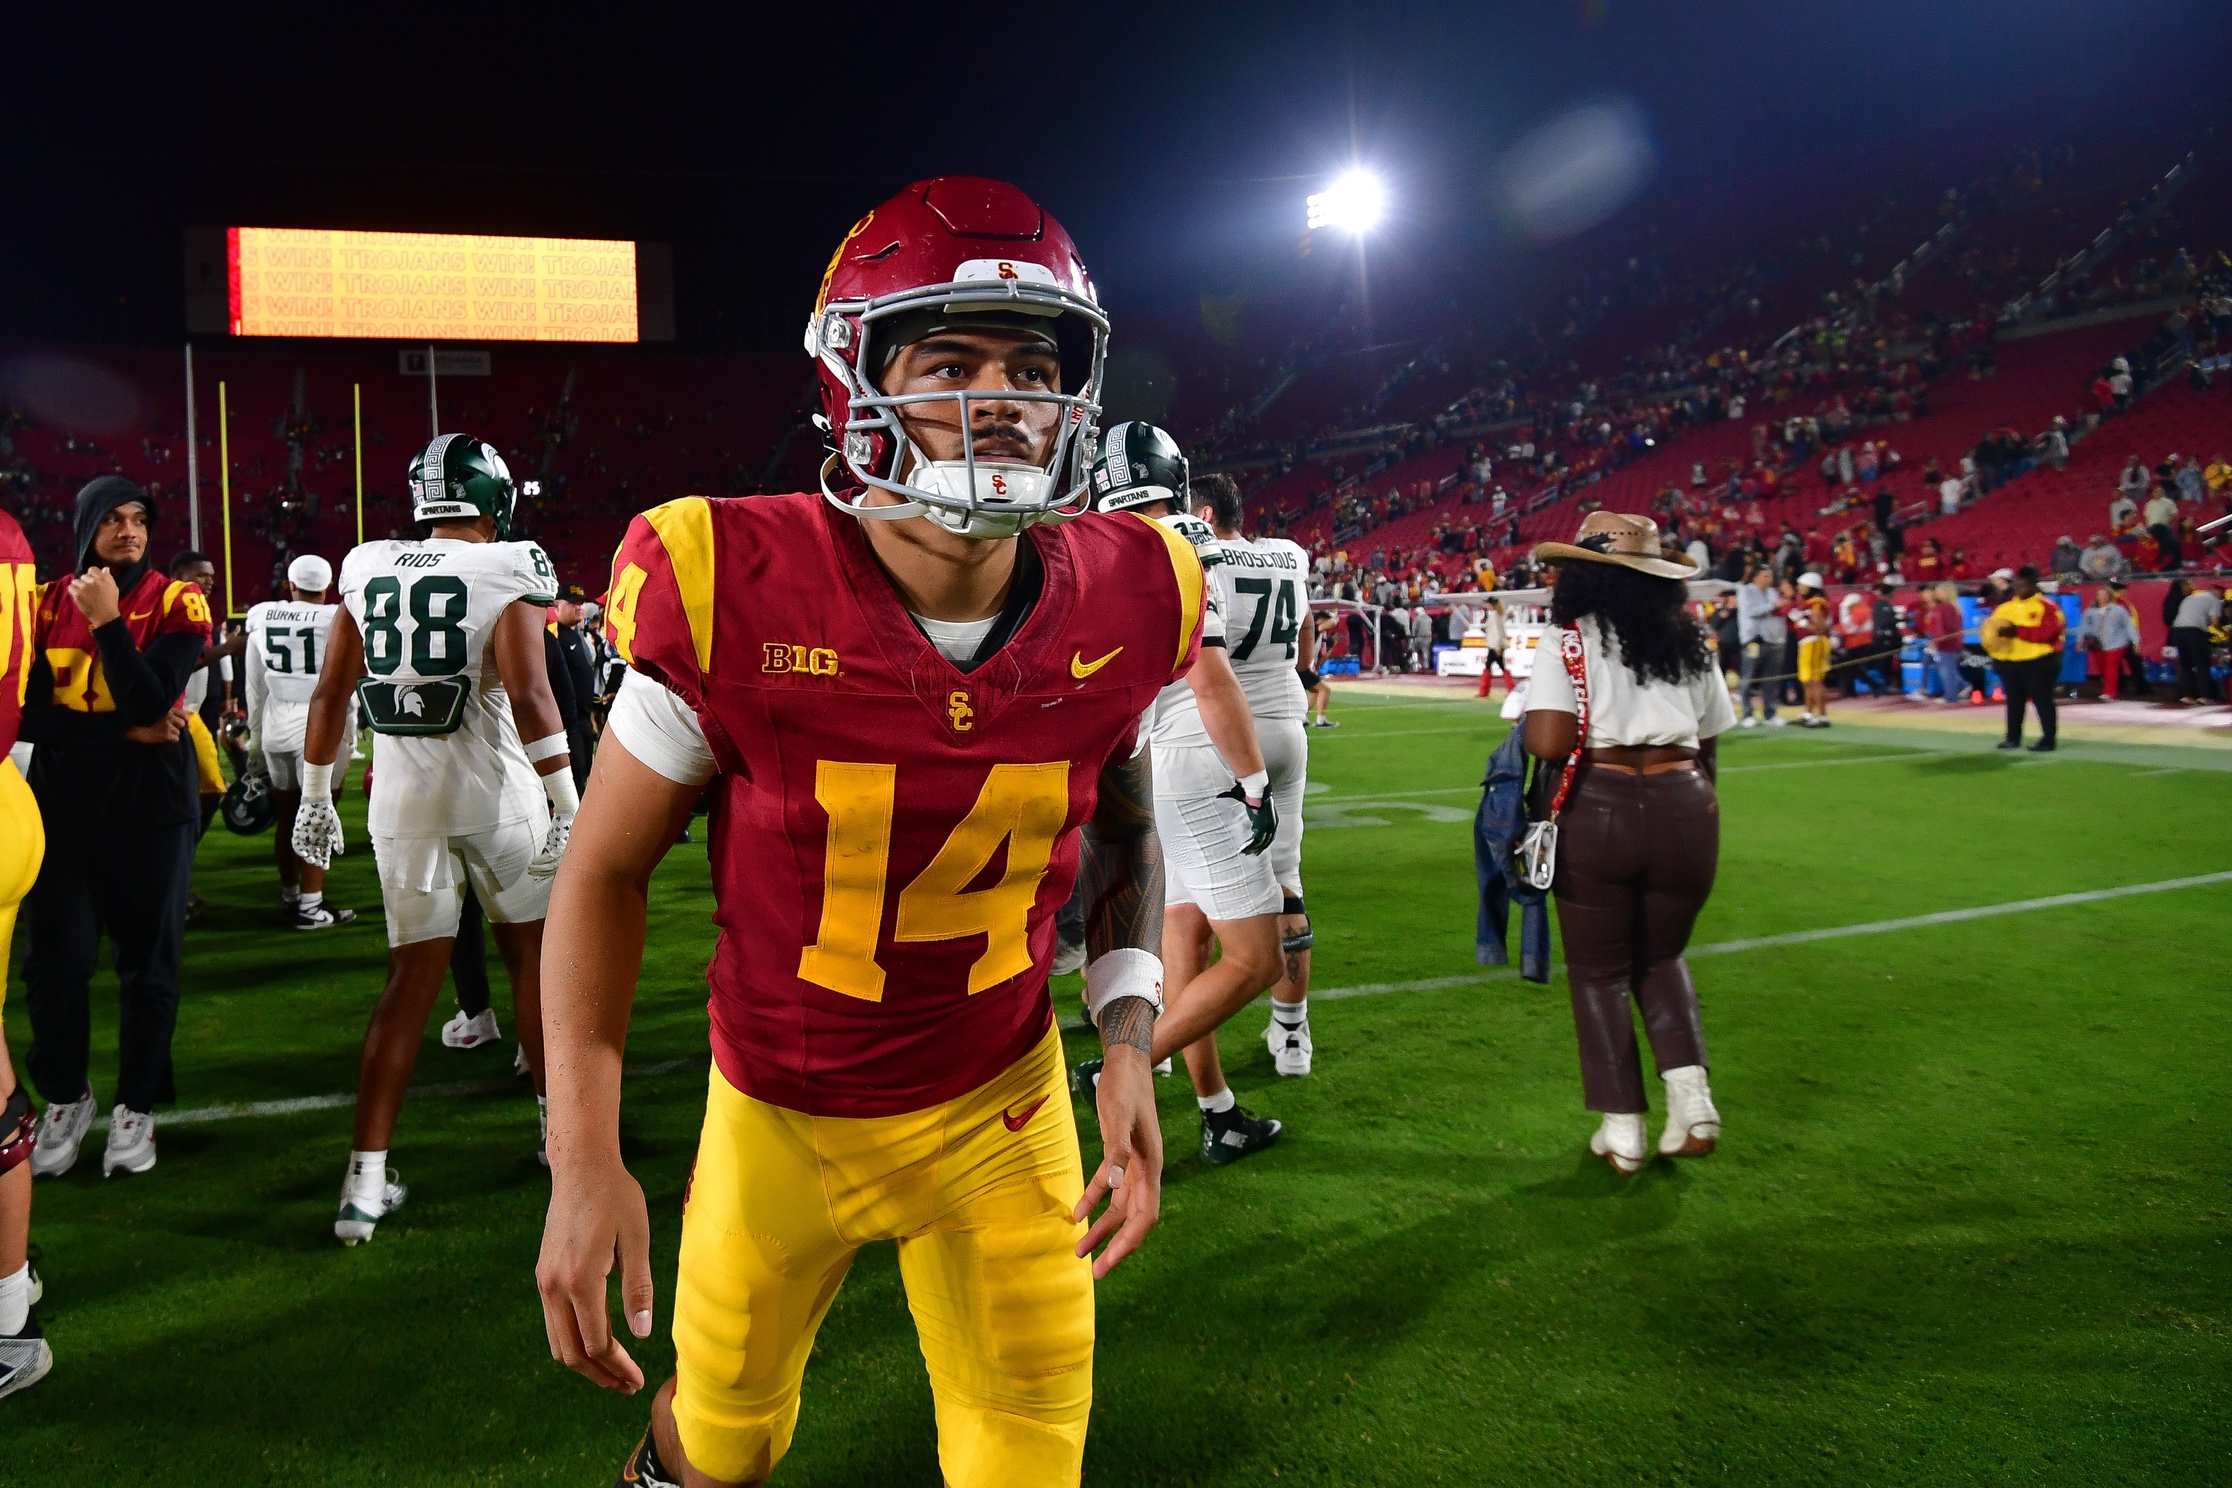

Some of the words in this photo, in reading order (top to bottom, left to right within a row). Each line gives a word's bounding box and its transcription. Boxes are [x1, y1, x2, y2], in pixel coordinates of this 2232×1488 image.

[265, 247, 332, 267] WIN!
[340, 249, 466, 271] TROJANS
[471, 253, 535, 274] WIN!
[265, 272, 333, 292] WIN!
[341, 274, 467, 295] TROJANS
[472, 277, 536, 297] WIN!
[266, 296, 333, 317] WIN!
[341, 298, 467, 319] TROJANS
[473, 302, 536, 321] WIN!
[421, 504, 462, 515] SPARTANS
[1108, 490, 1150, 507] SPARTANS
[394, 553, 446, 567] RIOS
[529, 548, 557, 580] 8
[1221, 548, 1297, 570] BROSCIOUS
[266, 609, 319, 622] BURNETT
[364, 575, 468, 676] 88
[1230, 577, 1298, 660] 74
[265, 626, 316, 674] 51
[949, 691, 974, 731] SC
[797, 759, 1070, 1002] 14
